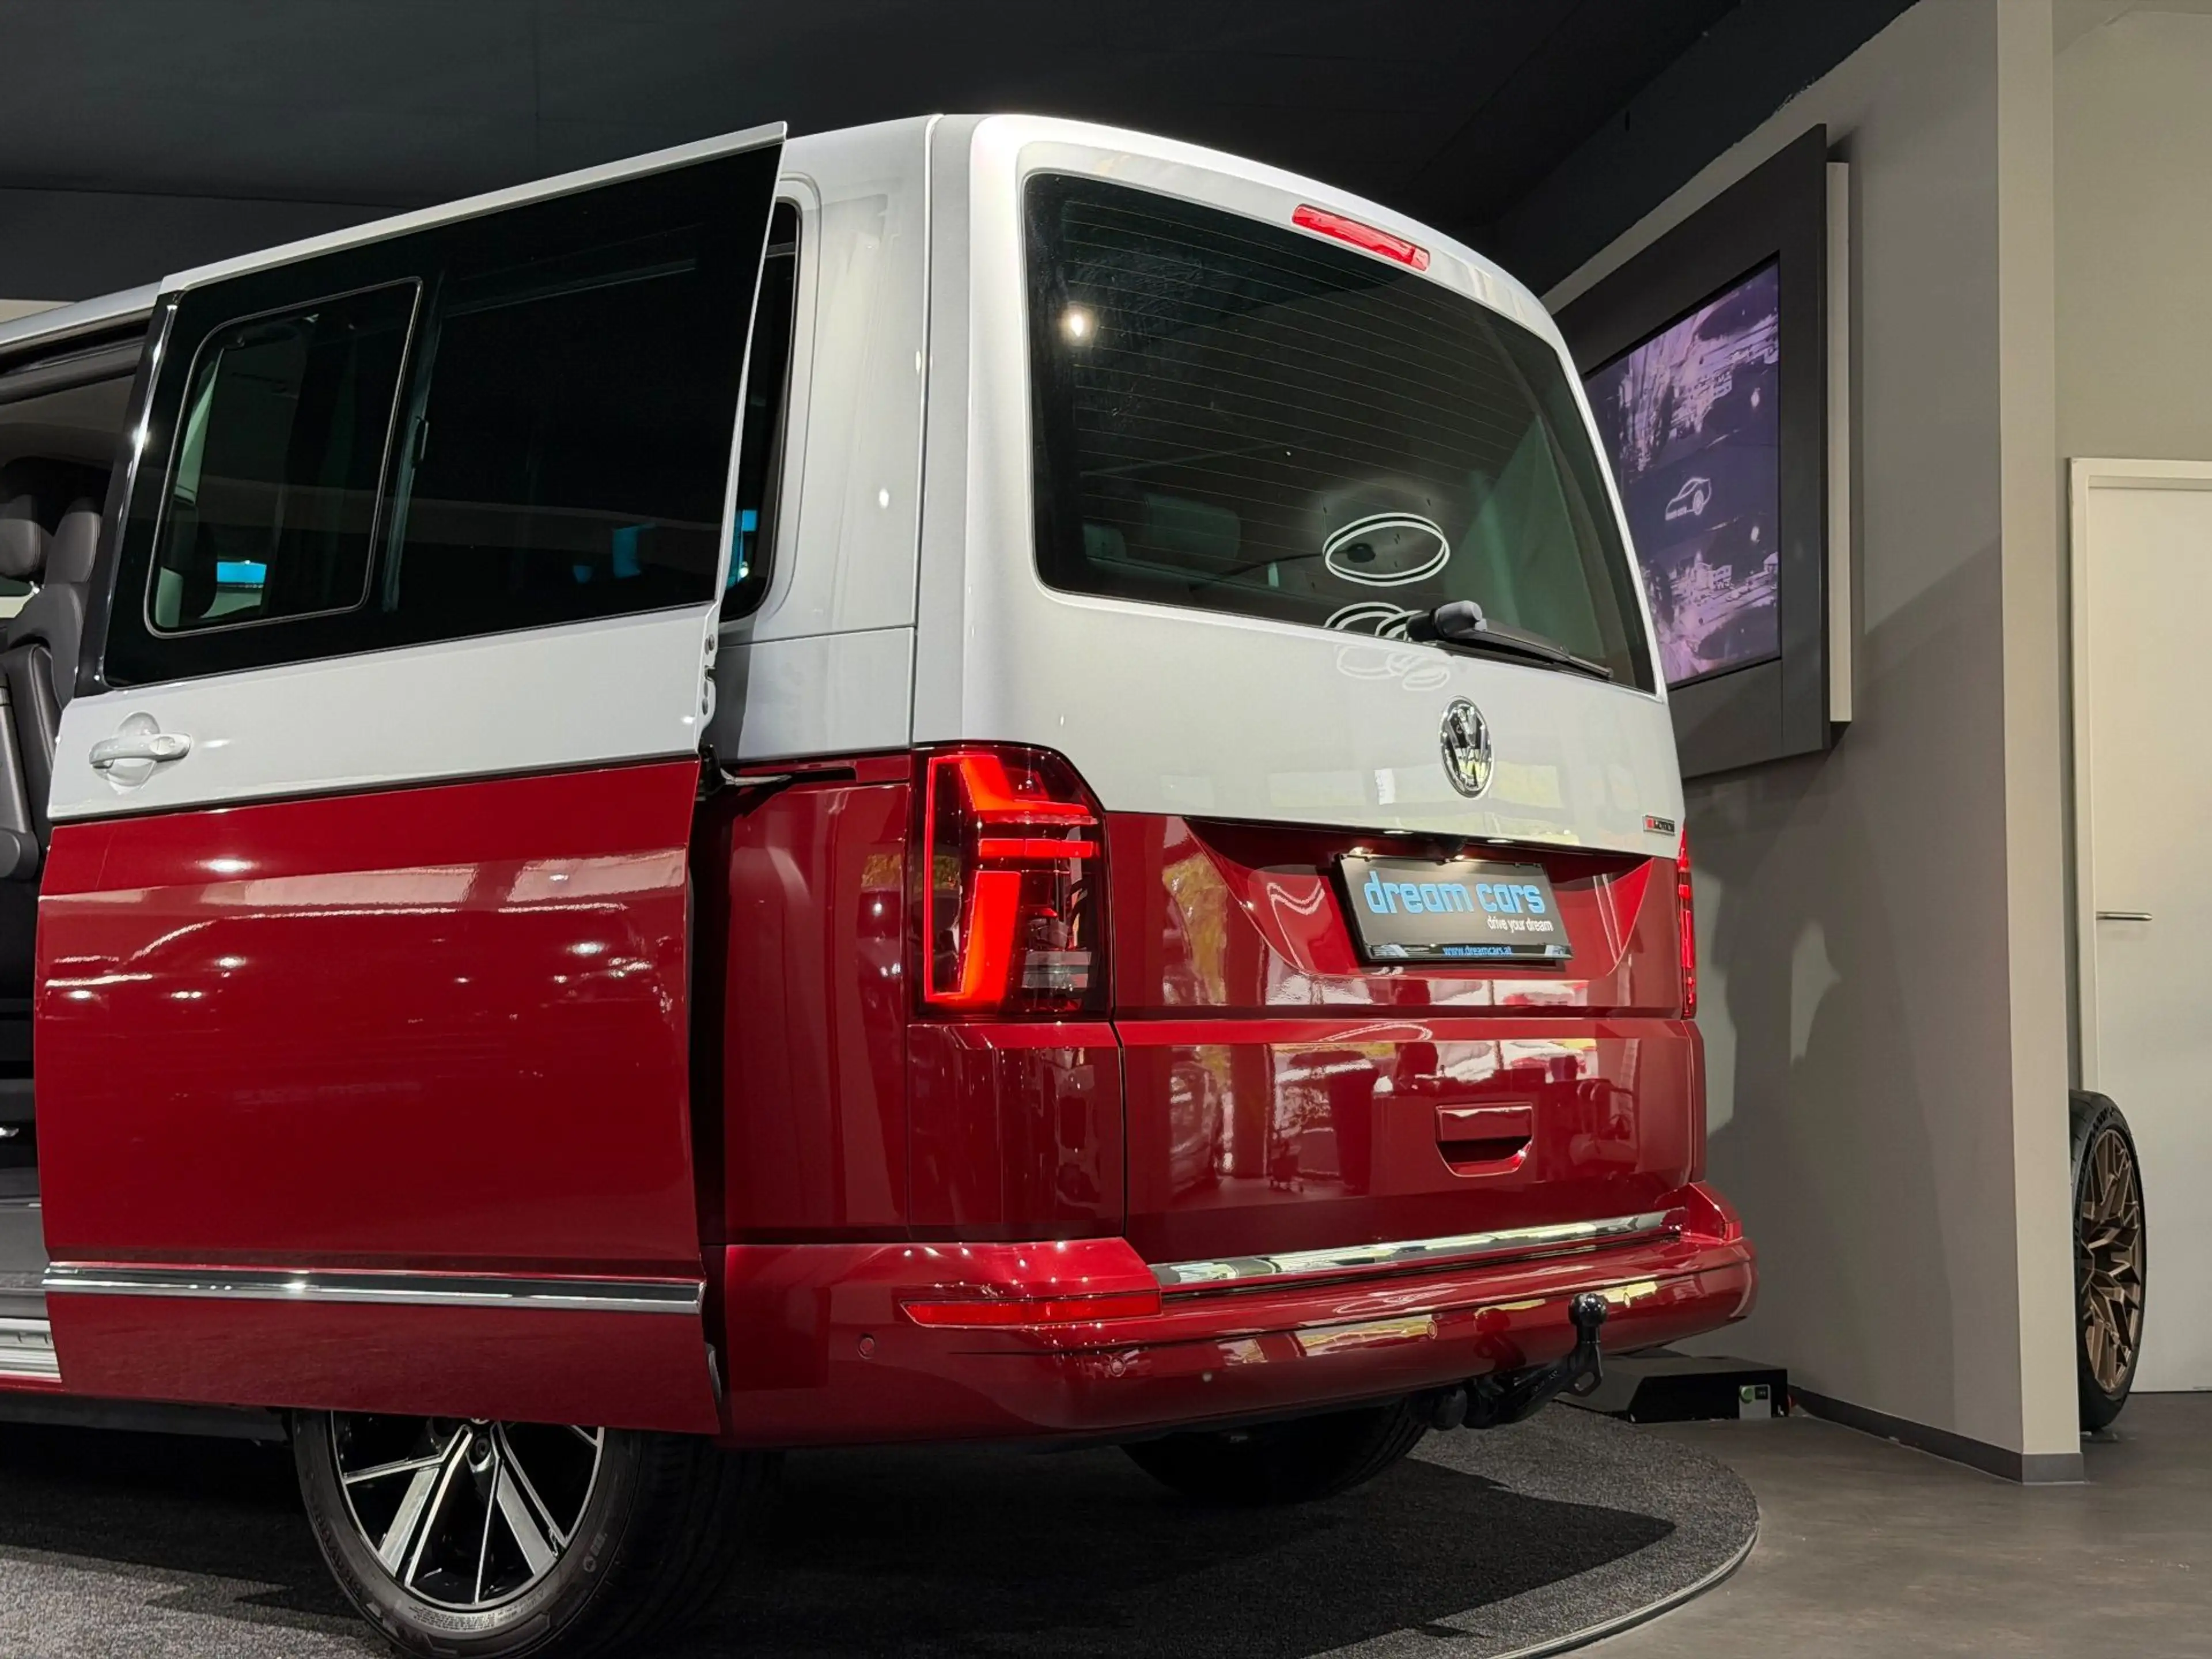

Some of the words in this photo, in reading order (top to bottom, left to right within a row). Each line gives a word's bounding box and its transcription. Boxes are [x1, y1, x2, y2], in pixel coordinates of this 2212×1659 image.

[1364, 870, 1474, 914] dream
[1475, 883, 1546, 914] cars
[1487, 915, 1508, 930] drive
[1507, 919, 1525, 933] your
[1525, 917, 1554, 931] dream
